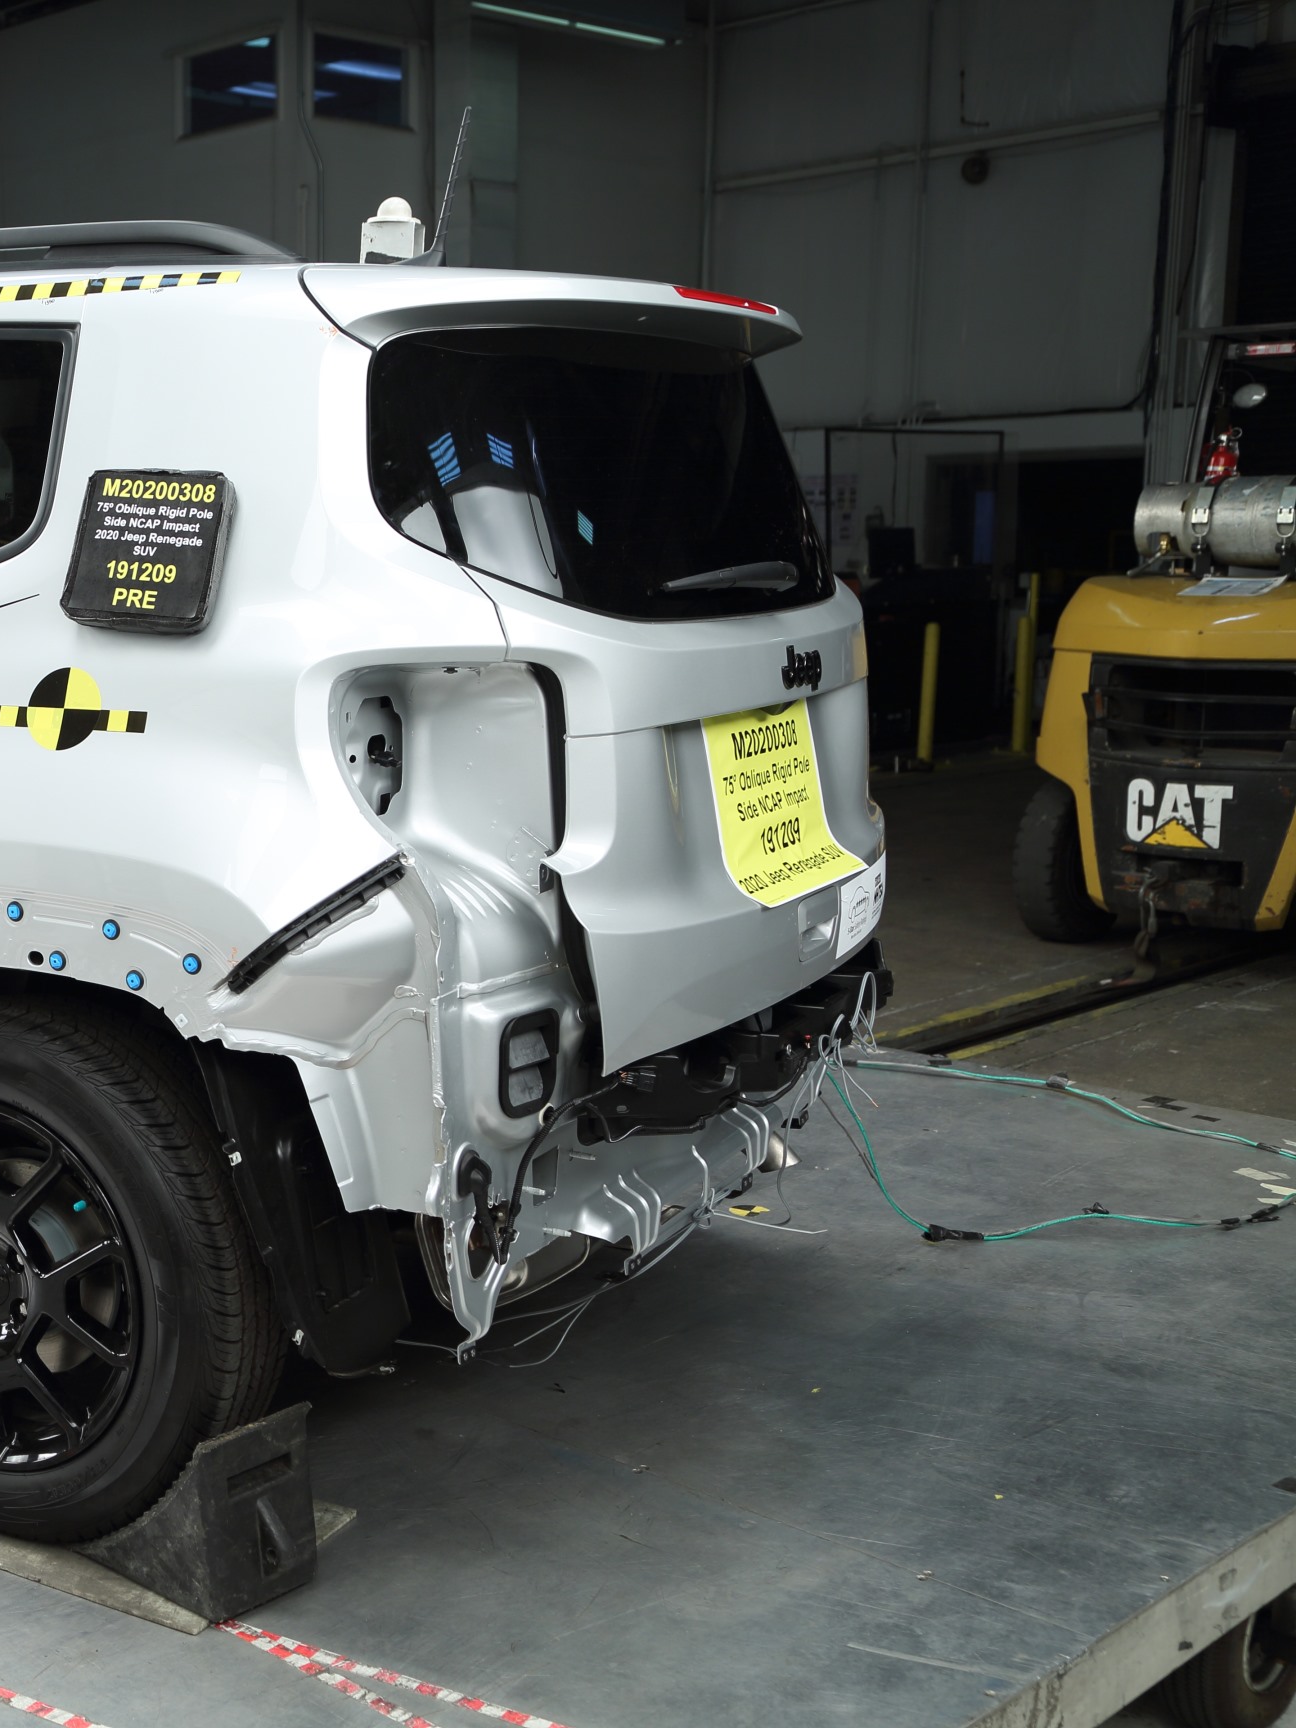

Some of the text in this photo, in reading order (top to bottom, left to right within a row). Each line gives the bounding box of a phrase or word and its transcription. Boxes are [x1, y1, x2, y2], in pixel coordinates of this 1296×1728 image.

[102, 478, 216, 503] M20200308
[103, 517, 200, 534] Side NCAP Impact
[115, 503, 156, 516] Oblique
[158, 506, 187, 519] Rigid
[189, 508, 214, 520] Pole
[94, 529, 203, 548] 2020 Jeep Renegade
[133, 545, 157, 556] SUV
[106, 560, 177, 584] 191209
[112, 587, 158, 609] PRE
[781, 645, 822, 692] Jeep
[731, 719, 798, 760] M20200308
[739, 769, 771, 791] Oblique
[772, 759, 792, 784] Rigid
[794, 755, 810, 775] Pole
[736, 784, 809, 822] Side NCAP Impact
[1126, 777, 1234, 850] CAT
[760, 817, 801, 855] 191209
[739, 843, 845, 894] 2020 Jeep Renegade SUV
